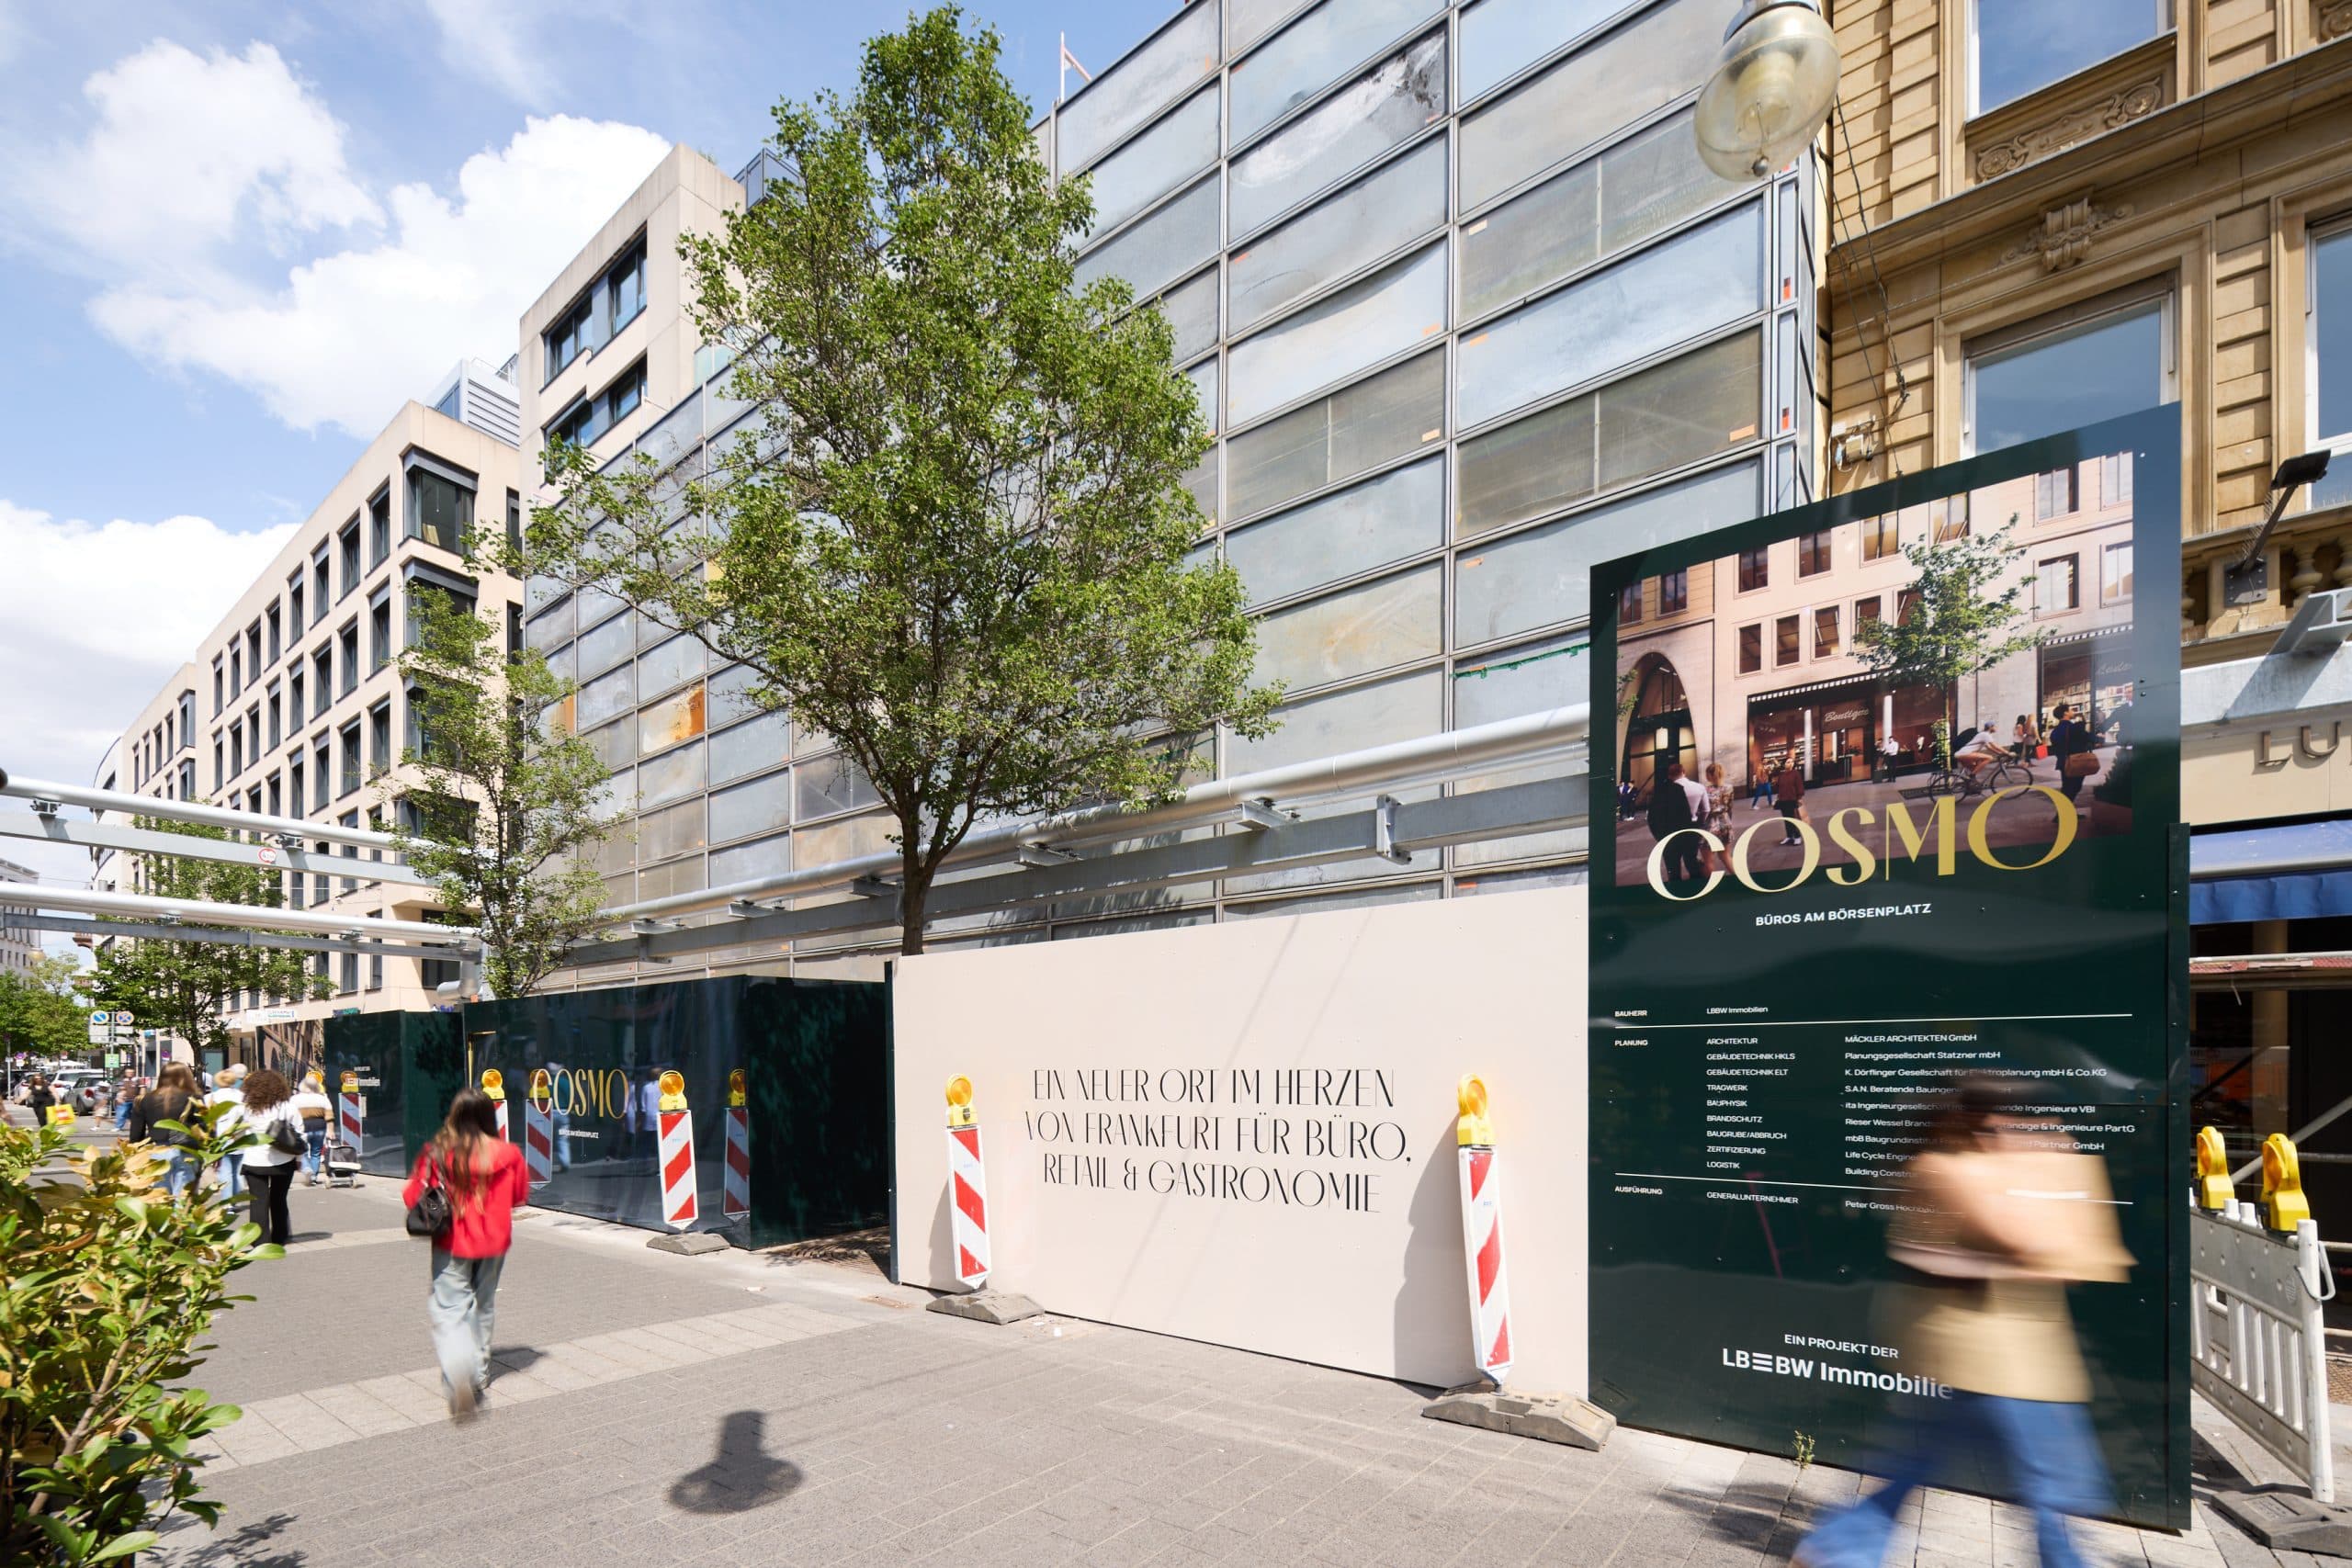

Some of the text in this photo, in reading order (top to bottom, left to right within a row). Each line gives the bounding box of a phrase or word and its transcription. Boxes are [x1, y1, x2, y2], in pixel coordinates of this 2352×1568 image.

[2257, 720, 2341, 765] LU
[1646, 785, 2079, 901] COSMO
[1755, 903, 1932, 927] BÜROS AM BÖRSENPLATZ
[1614, 1010, 1647, 1018] BAUHERR
[1614, 1039, 1648, 1047] PLANUNG
[1706, 1037, 1758, 1045] ARCHITEKTUR
[1844, 1033, 1977, 1043] MÄCKLER ARCHITEKTEN GmbH
[1706, 1052, 1774, 1060] GEBÄUDETECHNIK
[1844, 1051, 1936, 1061] Planungsgesellschaft
[1937, 1051, 1976, 1059] Statzner
[1706, 1067, 1774, 1076] GEBÄUDETECHNIK
[1844, 1068, 1853, 1077] K.
[1854, 1068, 1896, 1078] Dörflinger
[1897, 1068, 1952, 1077] Gesellschaft
[2041, 1068, 2065, 1077] mbH
[2066, 1068, 2074, 1077] &
[1033, 1068, 1395, 1108] EIN NEUER ORT IM HERZEN
[1870, 1085, 1915, 1093] Beratende
[533, 1068, 629, 1120] COSMO
[1845, 1101, 1856, 1110] ita
[2025, 1104, 2077, 1114] Ingenieure
[2078, 1105, 2096, 1113] VBI
[1845, 1118, 1871, 1126] Rieser
[2049, 1123, 2102, 1134] Ingenieure
[2104, 1124, 2135, 1133] PartG
[1024, 1111, 1074, 1144] VON
[1085, 1112, 1226, 1151] FRANKFURT
[1237, 1111, 1291, 1155] FÜR
[1706, 1130, 1787, 1139] BAUGRUBE/ABBRUCH
[1845, 1134, 1864, 1143] mbB
[2072, 1141, 2105, 1150] GmbH
[1706, 1145, 1766, 1155] ZERTIFIZIERUNG
[1861, 1151, 1885, 1160] Cycle
[1706, 1161, 1740, 1169] LOGISTIK
[1845, 1168, 1879, 1177] Building
[1044, 1153, 1381, 1213] RETAIL & GASTRONOMIE
[1614, 1185, 1663, 1195] AUSFÜHRUNG
[1706, 1191, 1799, 1204] GENERALUNTERNEHMER
[1845, 1200, 1869, 1208] Peter
[1869, 1201, 1894, 1211] Gross
[1783, 1334, 1899, 1359] EIN PROJEKT DER
[1820, 1361, 1953, 1400] Immobilie
